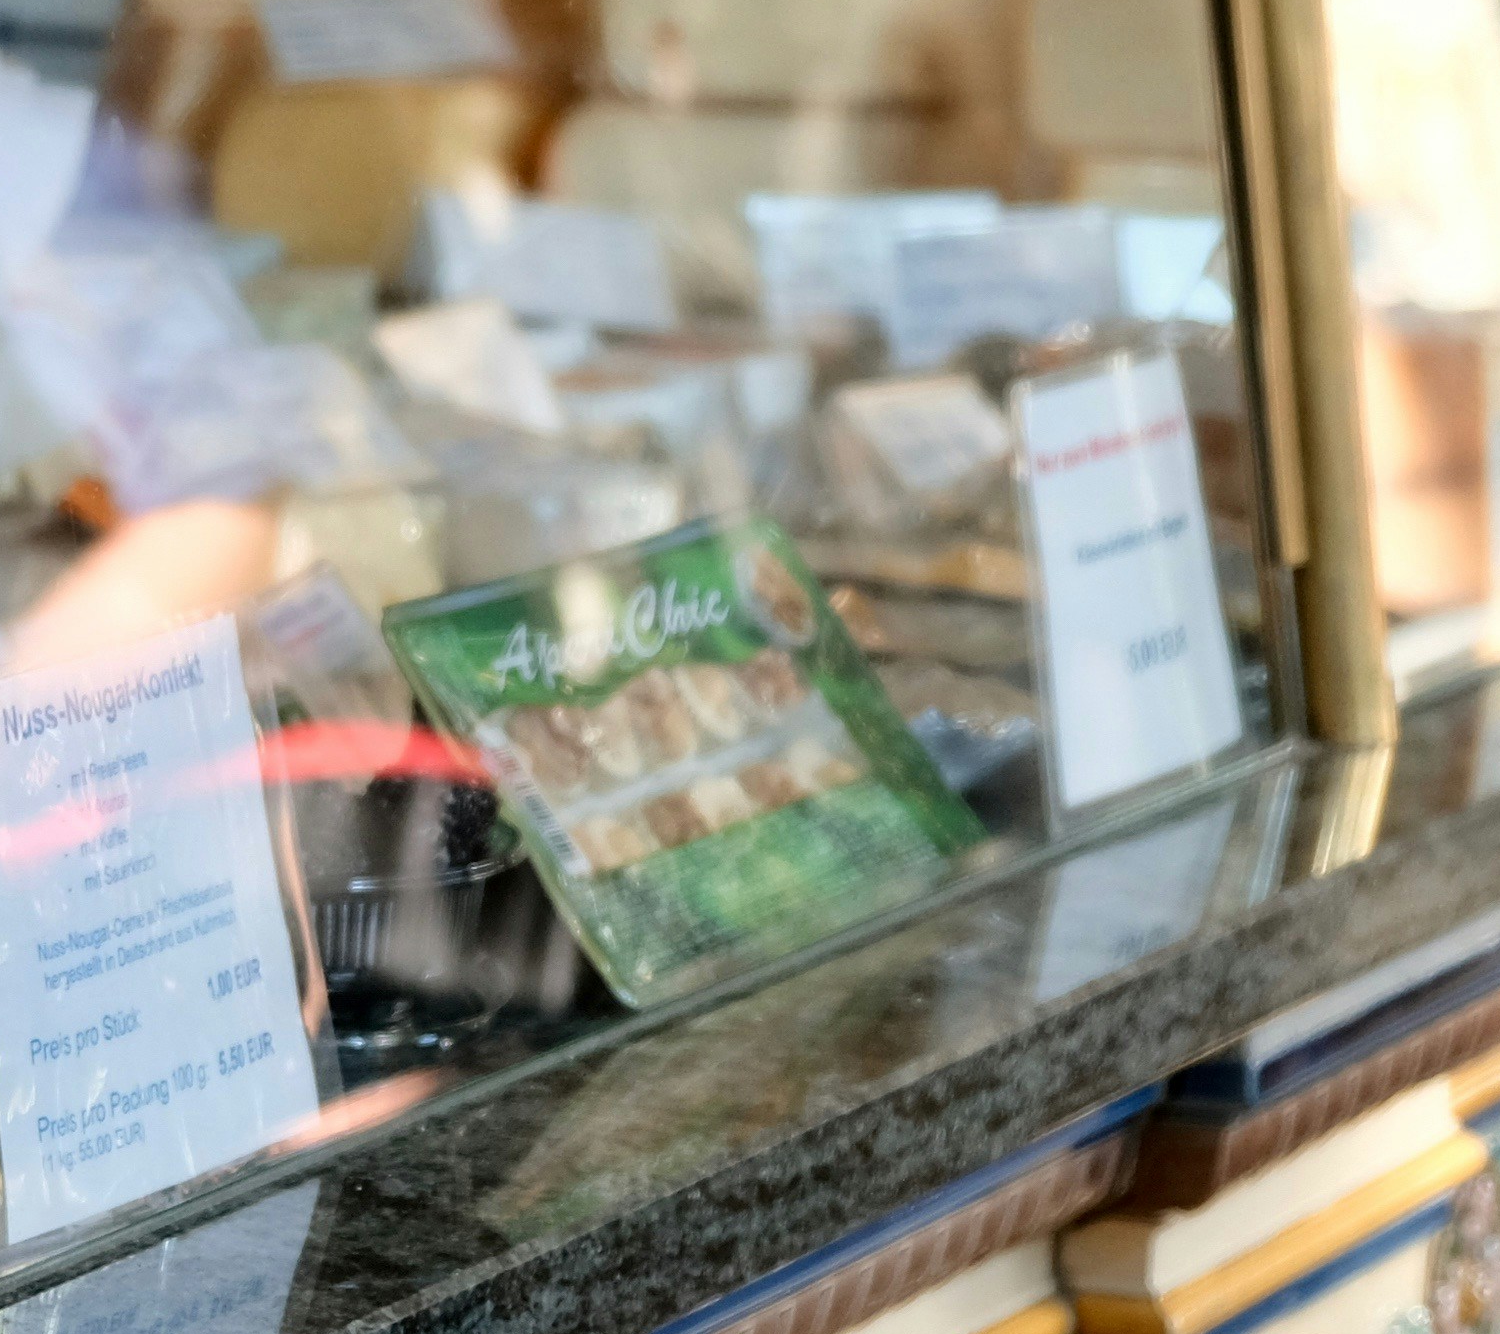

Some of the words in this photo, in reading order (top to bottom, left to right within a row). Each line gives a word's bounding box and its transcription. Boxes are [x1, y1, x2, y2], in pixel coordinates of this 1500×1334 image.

[234, 956, 262, 989] EUR
[30, 1033, 72, 1065] Preis
[76, 1025, 99, 1058] pro
[37, 1116, 77, 1142] Preis
[81, 1102, 107, 1137] pro
[109, 1078, 171, 1118] Packung
[171, 1063, 194, 1093] 100
[246, 1030, 276, 1063] EUR
